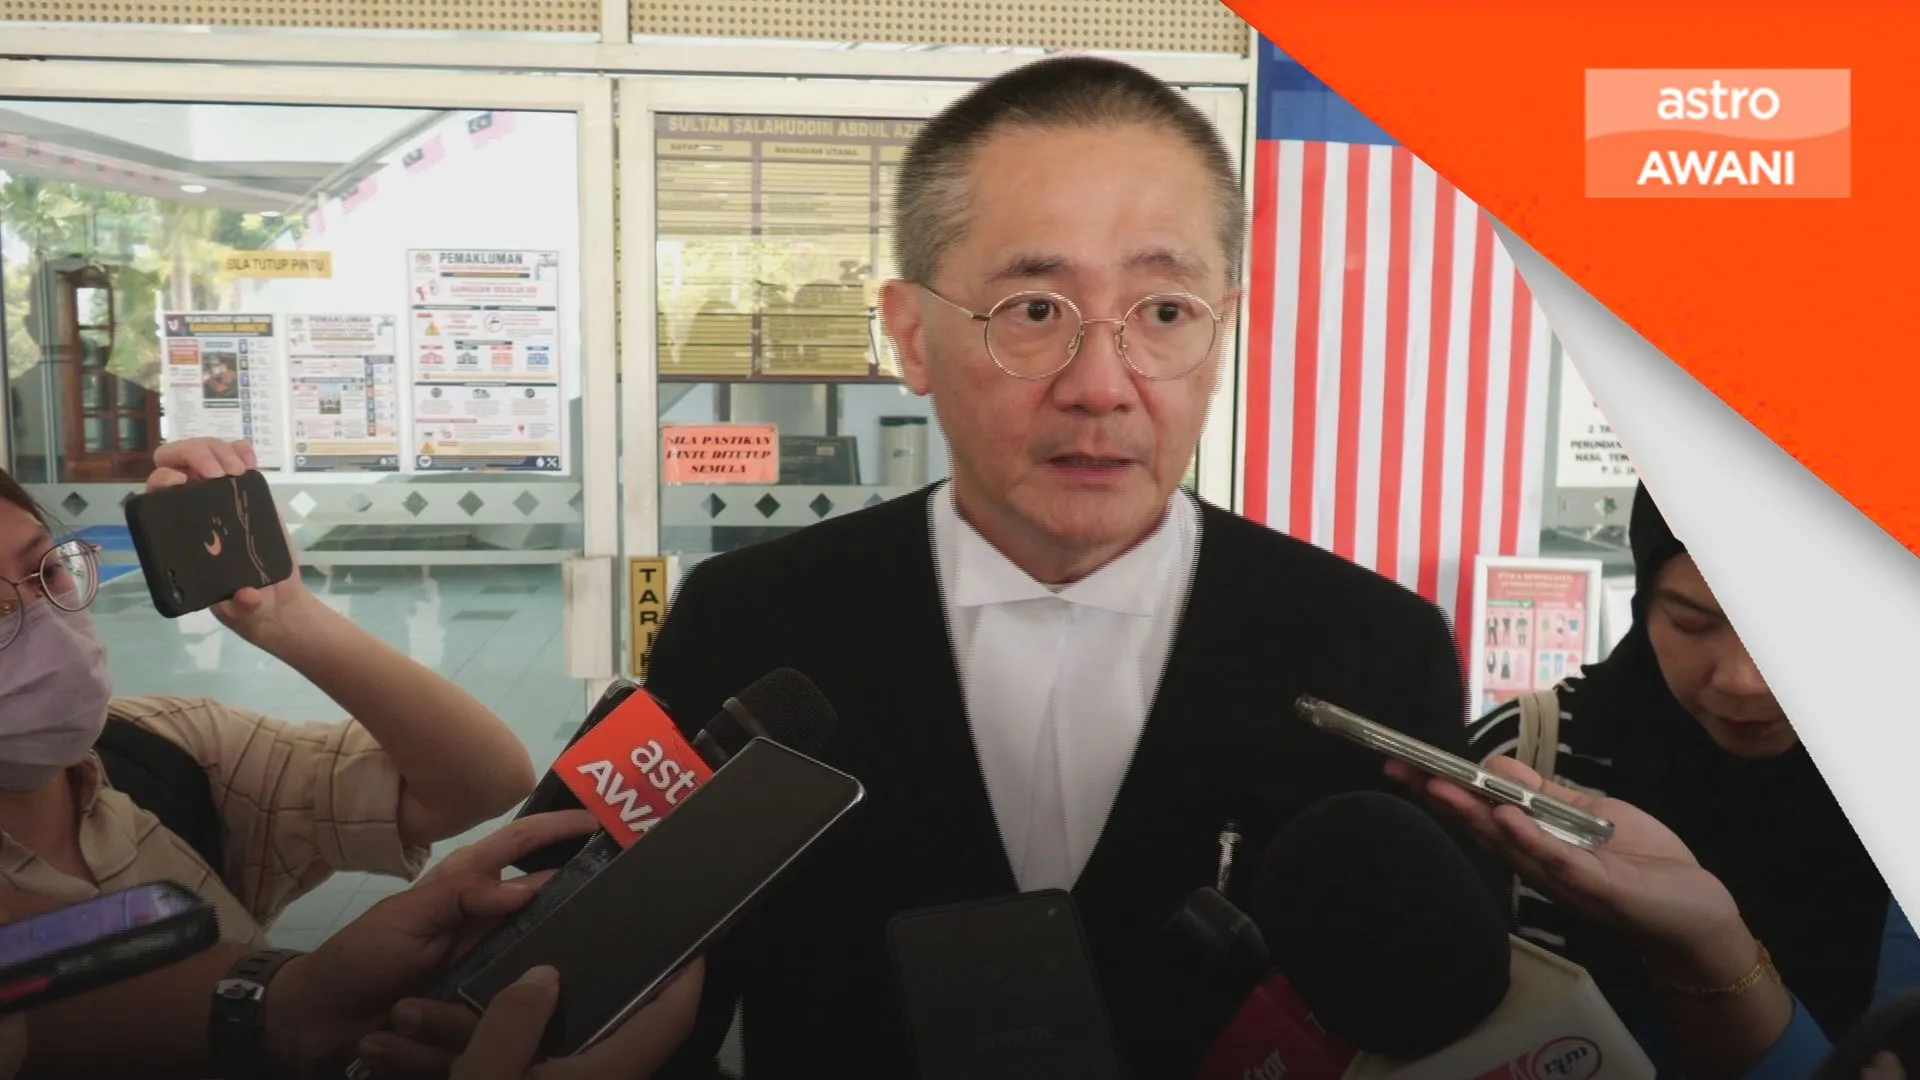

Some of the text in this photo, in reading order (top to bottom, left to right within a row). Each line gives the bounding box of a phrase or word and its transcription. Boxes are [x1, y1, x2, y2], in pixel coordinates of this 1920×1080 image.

[669, 117, 729, 133] SULTAN
[734, 119, 833, 136] SALAHUDDIN
[838, 122, 889, 137] ABDUL
[439, 252, 523, 265] PEMAKLUMAN
[227, 258, 324, 271] SILA TUTUP PINTU
[702, 436, 771, 445] PASTIKAN
[712, 451, 772, 460] DITUTUP
[690, 465, 746, 473] SEMULA
